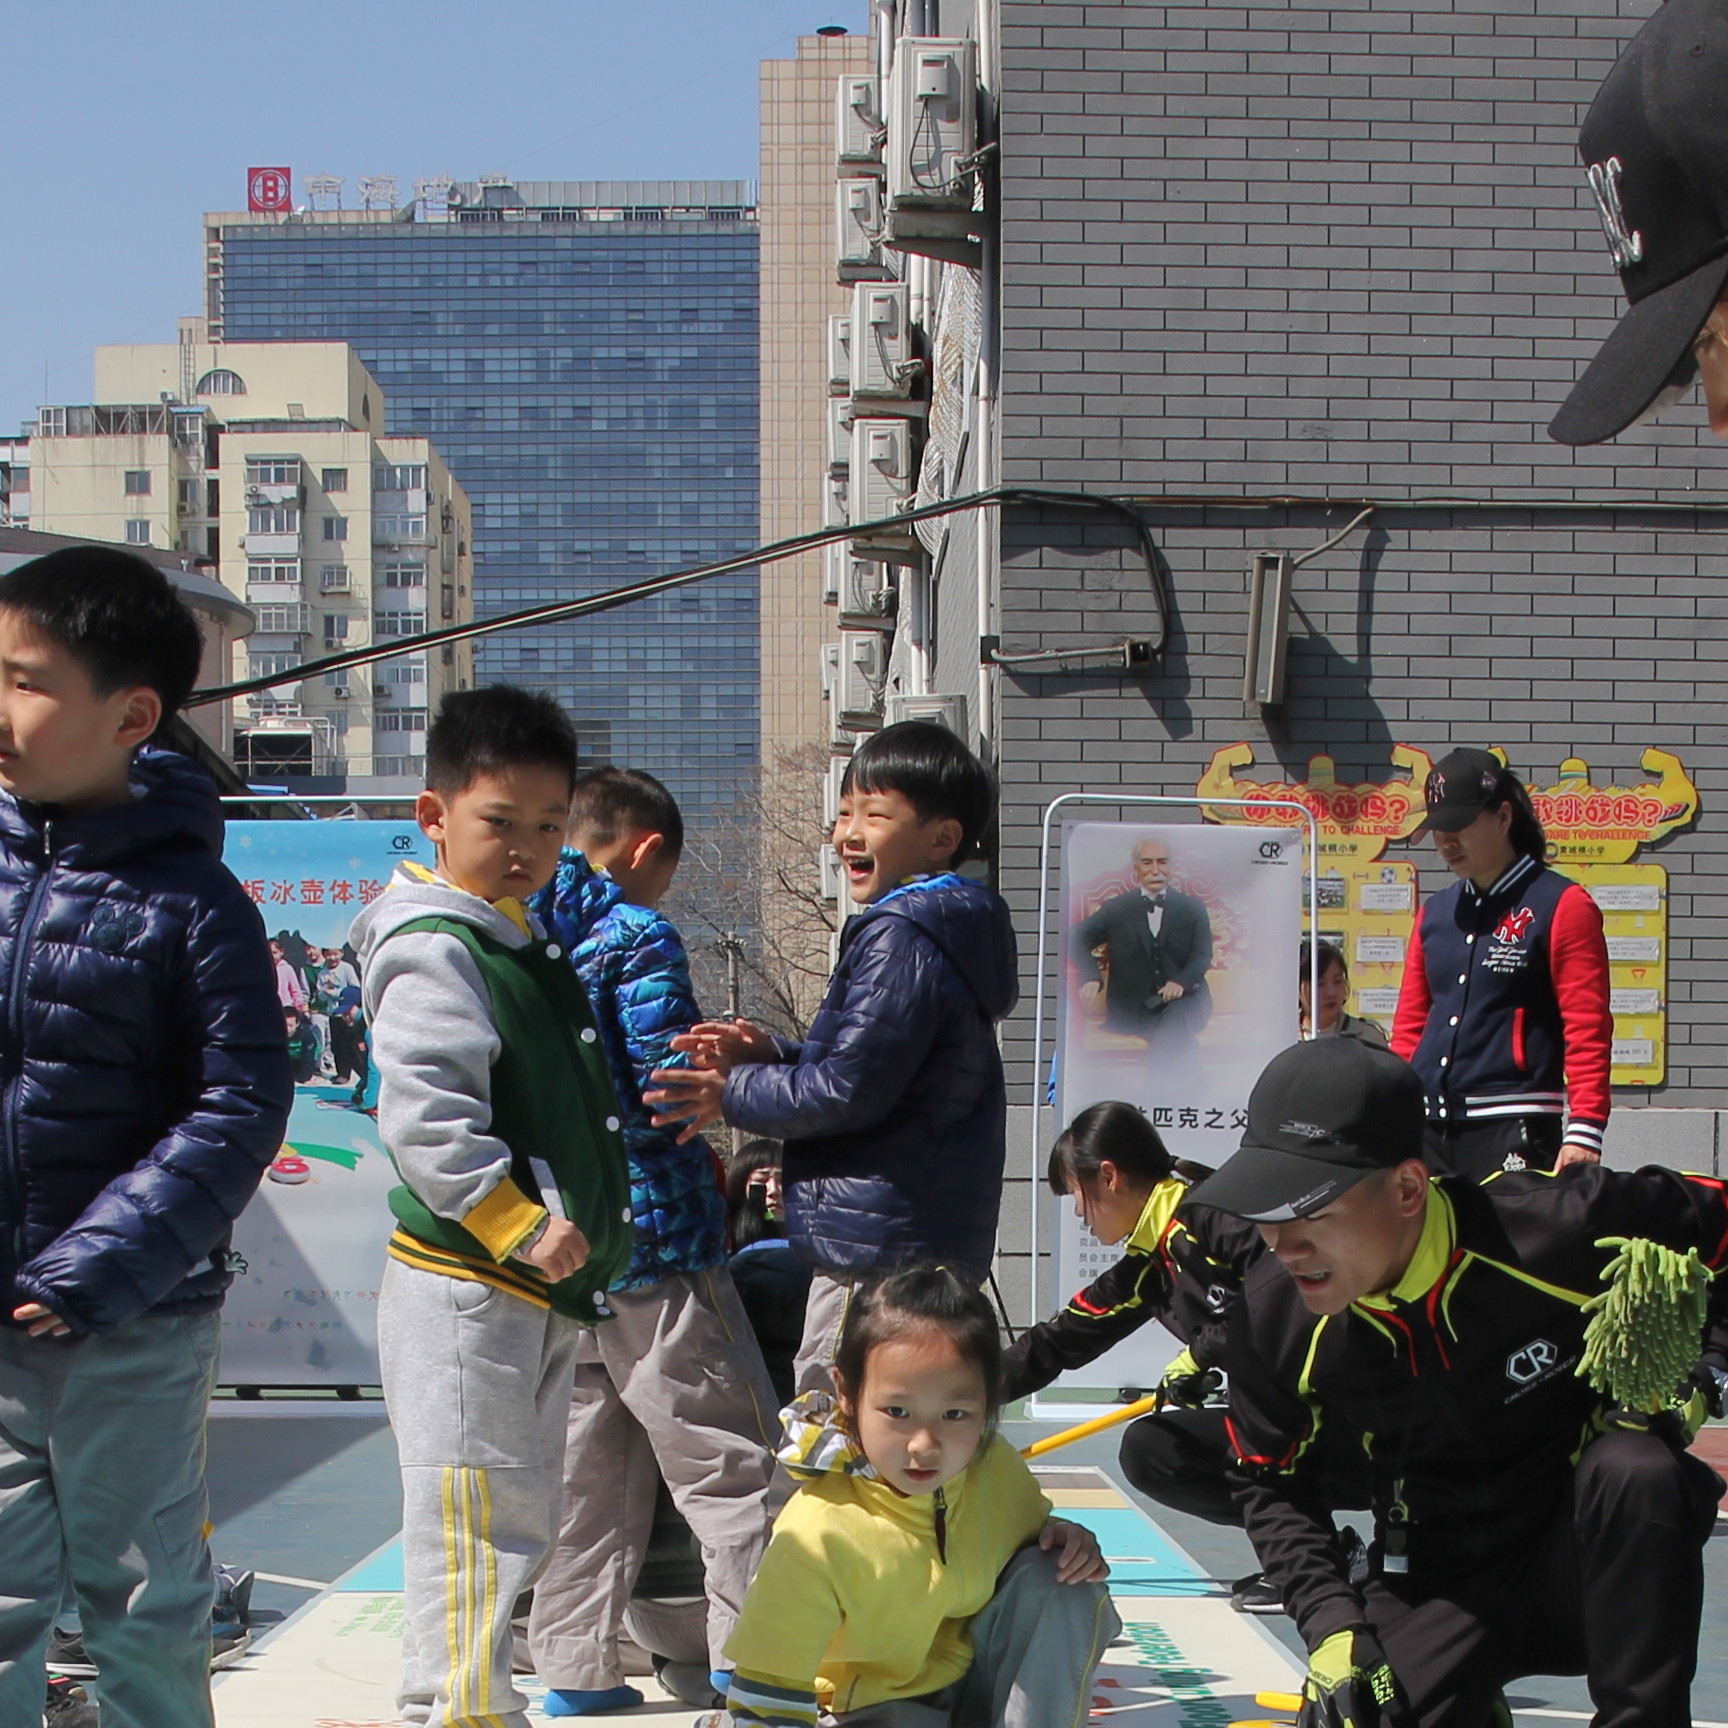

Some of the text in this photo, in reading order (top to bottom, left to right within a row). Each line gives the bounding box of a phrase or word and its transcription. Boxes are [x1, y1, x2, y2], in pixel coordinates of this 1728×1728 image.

[1322, 825, 1336, 835] TO
[1340, 825, 1401, 836] CHALLENGE
[1572, 830, 1589, 841] TO
[1591, 829, 1651, 841] CHALLENGE
[1140, 1106, 1249, 1130] 匹克之父
